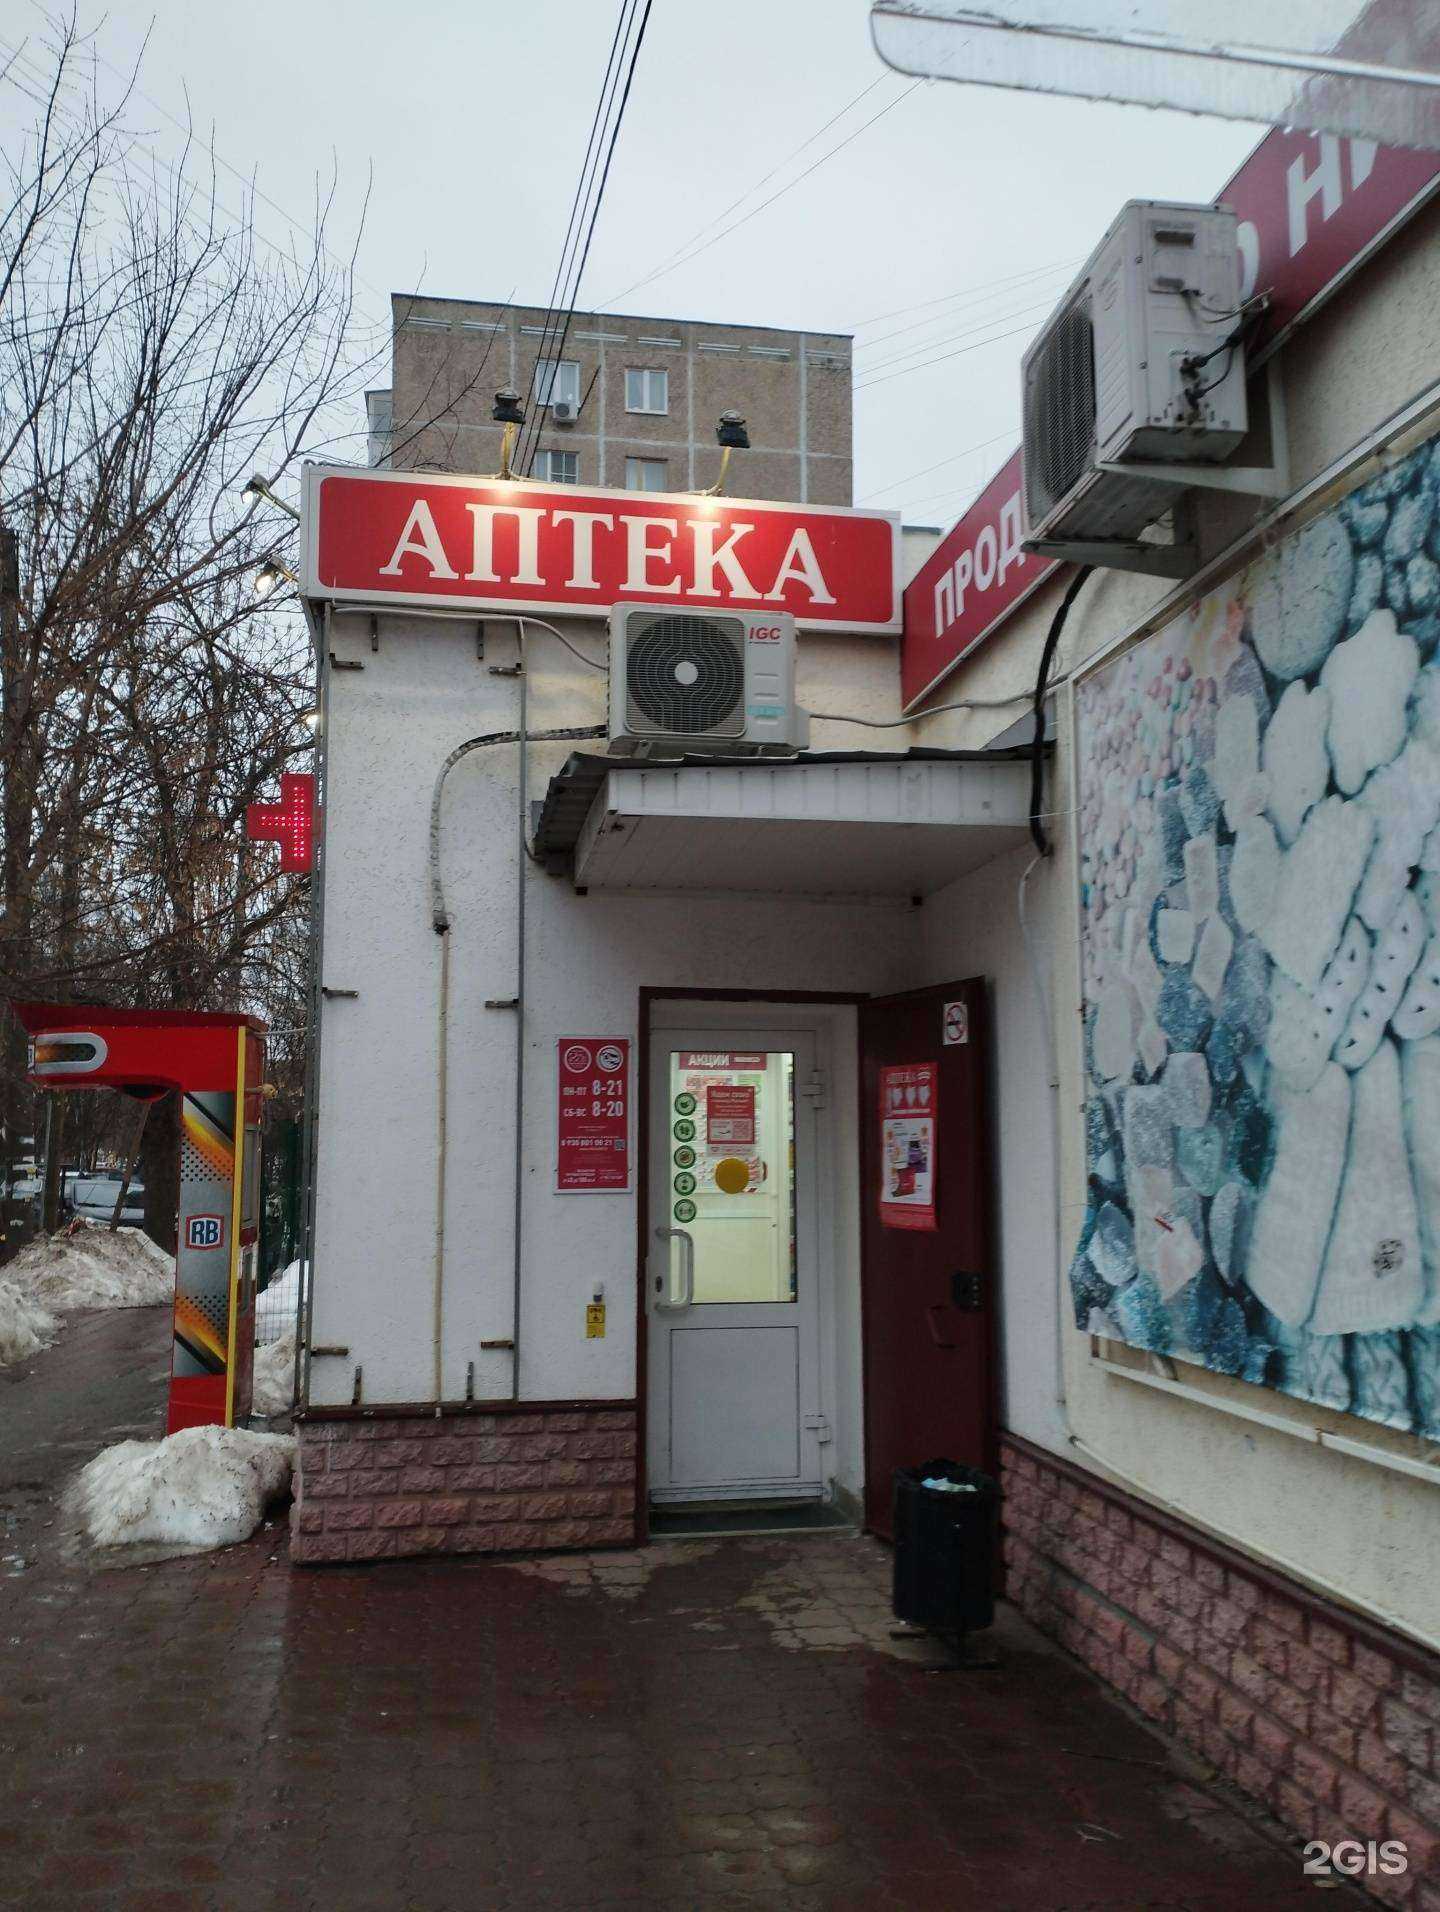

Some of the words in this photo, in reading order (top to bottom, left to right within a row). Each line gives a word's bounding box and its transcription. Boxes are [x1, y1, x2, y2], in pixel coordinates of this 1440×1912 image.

[379, 499, 838, 605] АПТЕКА
[749, 627, 781, 640] IGC
[688, 1054, 730, 1069] АКЦИИ
[593, 1079, 623, 1096] 8-21
[593, 1100, 624, 1117] 8-20
[191, 1219, 219, 1245] RB
